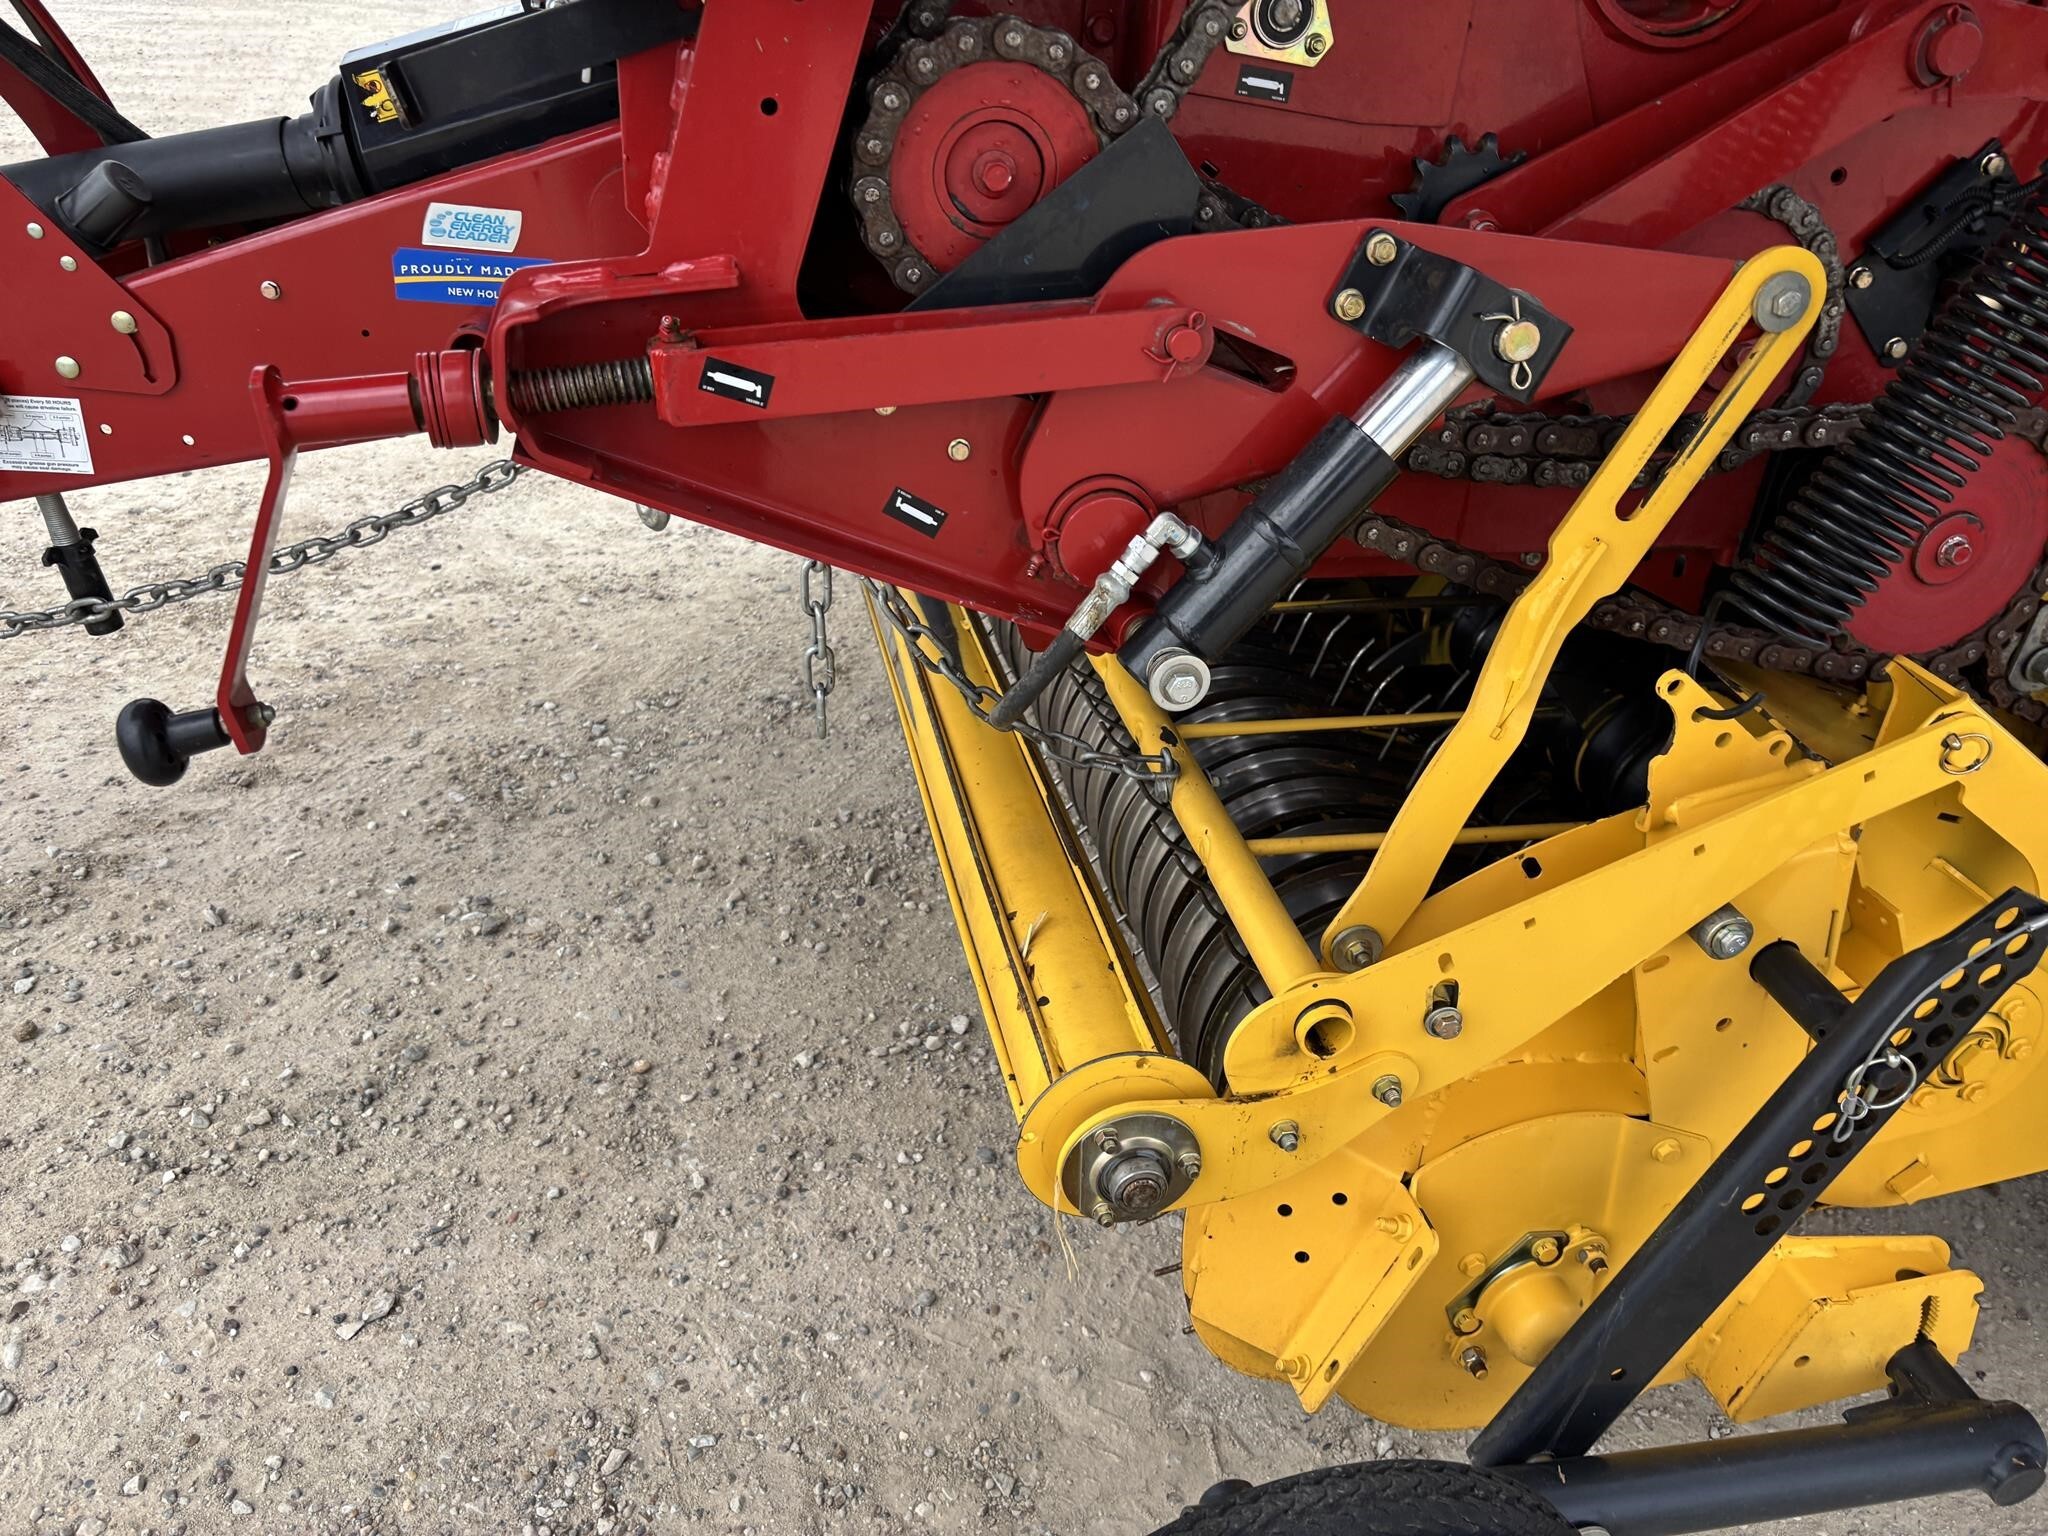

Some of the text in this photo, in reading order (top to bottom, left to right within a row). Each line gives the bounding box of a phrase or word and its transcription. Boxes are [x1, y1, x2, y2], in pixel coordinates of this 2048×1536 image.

[454, 212, 506, 225] CLEAN
[450, 222, 515, 235] ENERGY
[447, 231, 511, 244] LEADER
[400, 264, 520, 276] PROUDLY MAD
[448, 287, 474, 297] NEW
